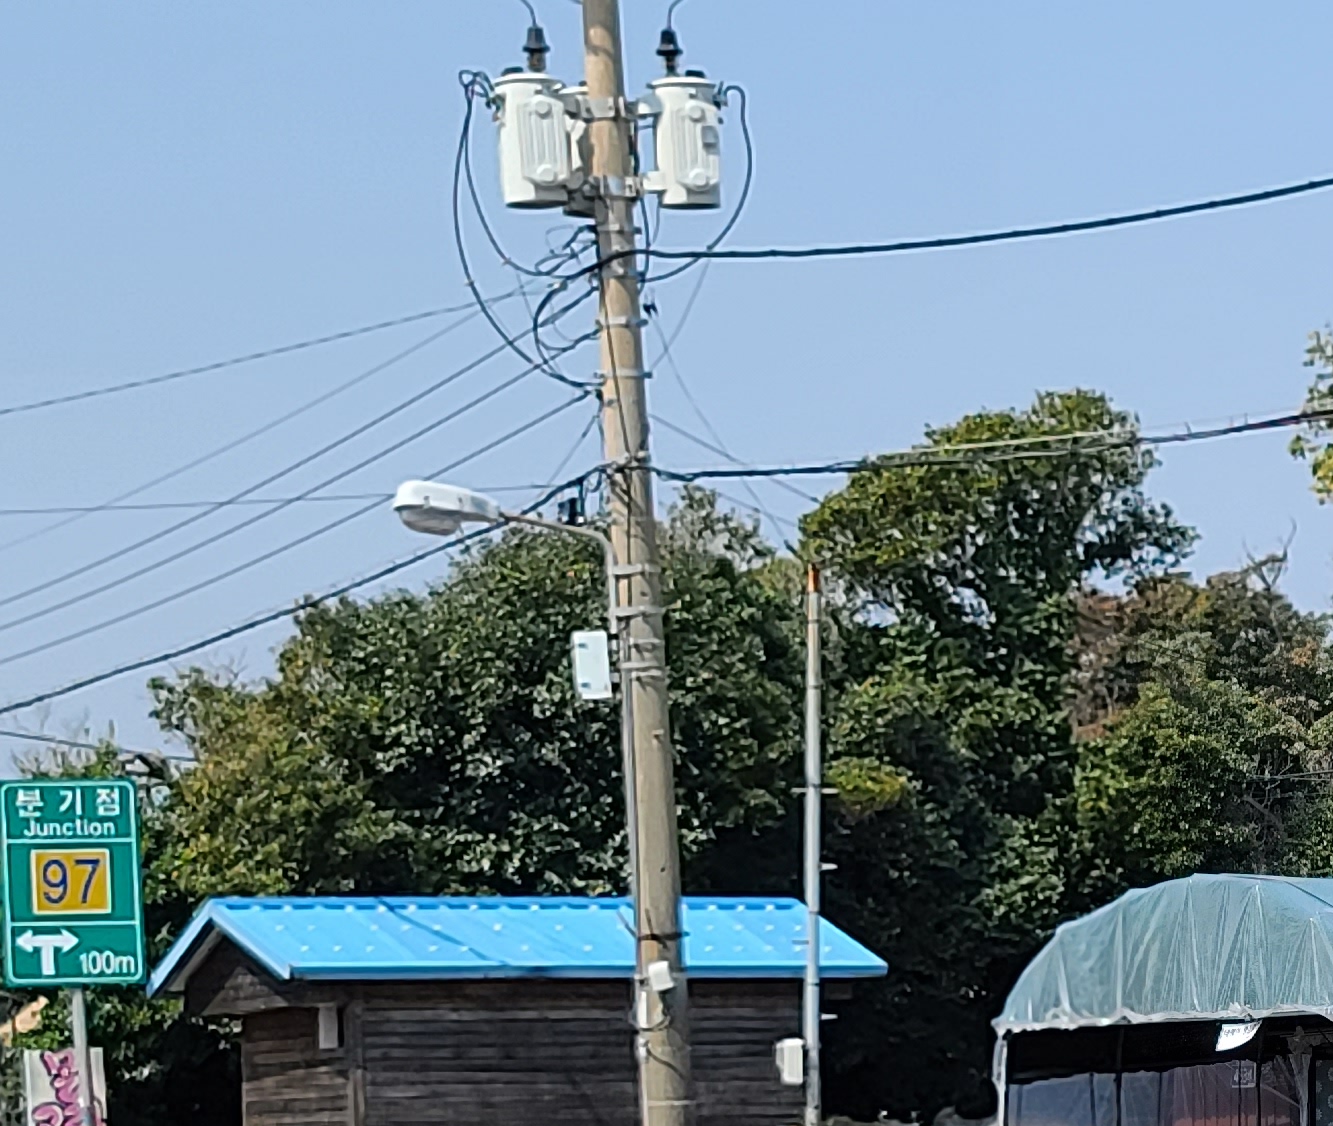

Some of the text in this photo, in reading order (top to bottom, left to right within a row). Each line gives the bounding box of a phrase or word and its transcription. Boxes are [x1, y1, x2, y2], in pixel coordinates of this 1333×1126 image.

[15, 786, 120, 817] 분기점
[23, 817, 115, 836] Junction
[42, 858, 101, 904] 97
[79, 950, 135, 975] 100m
